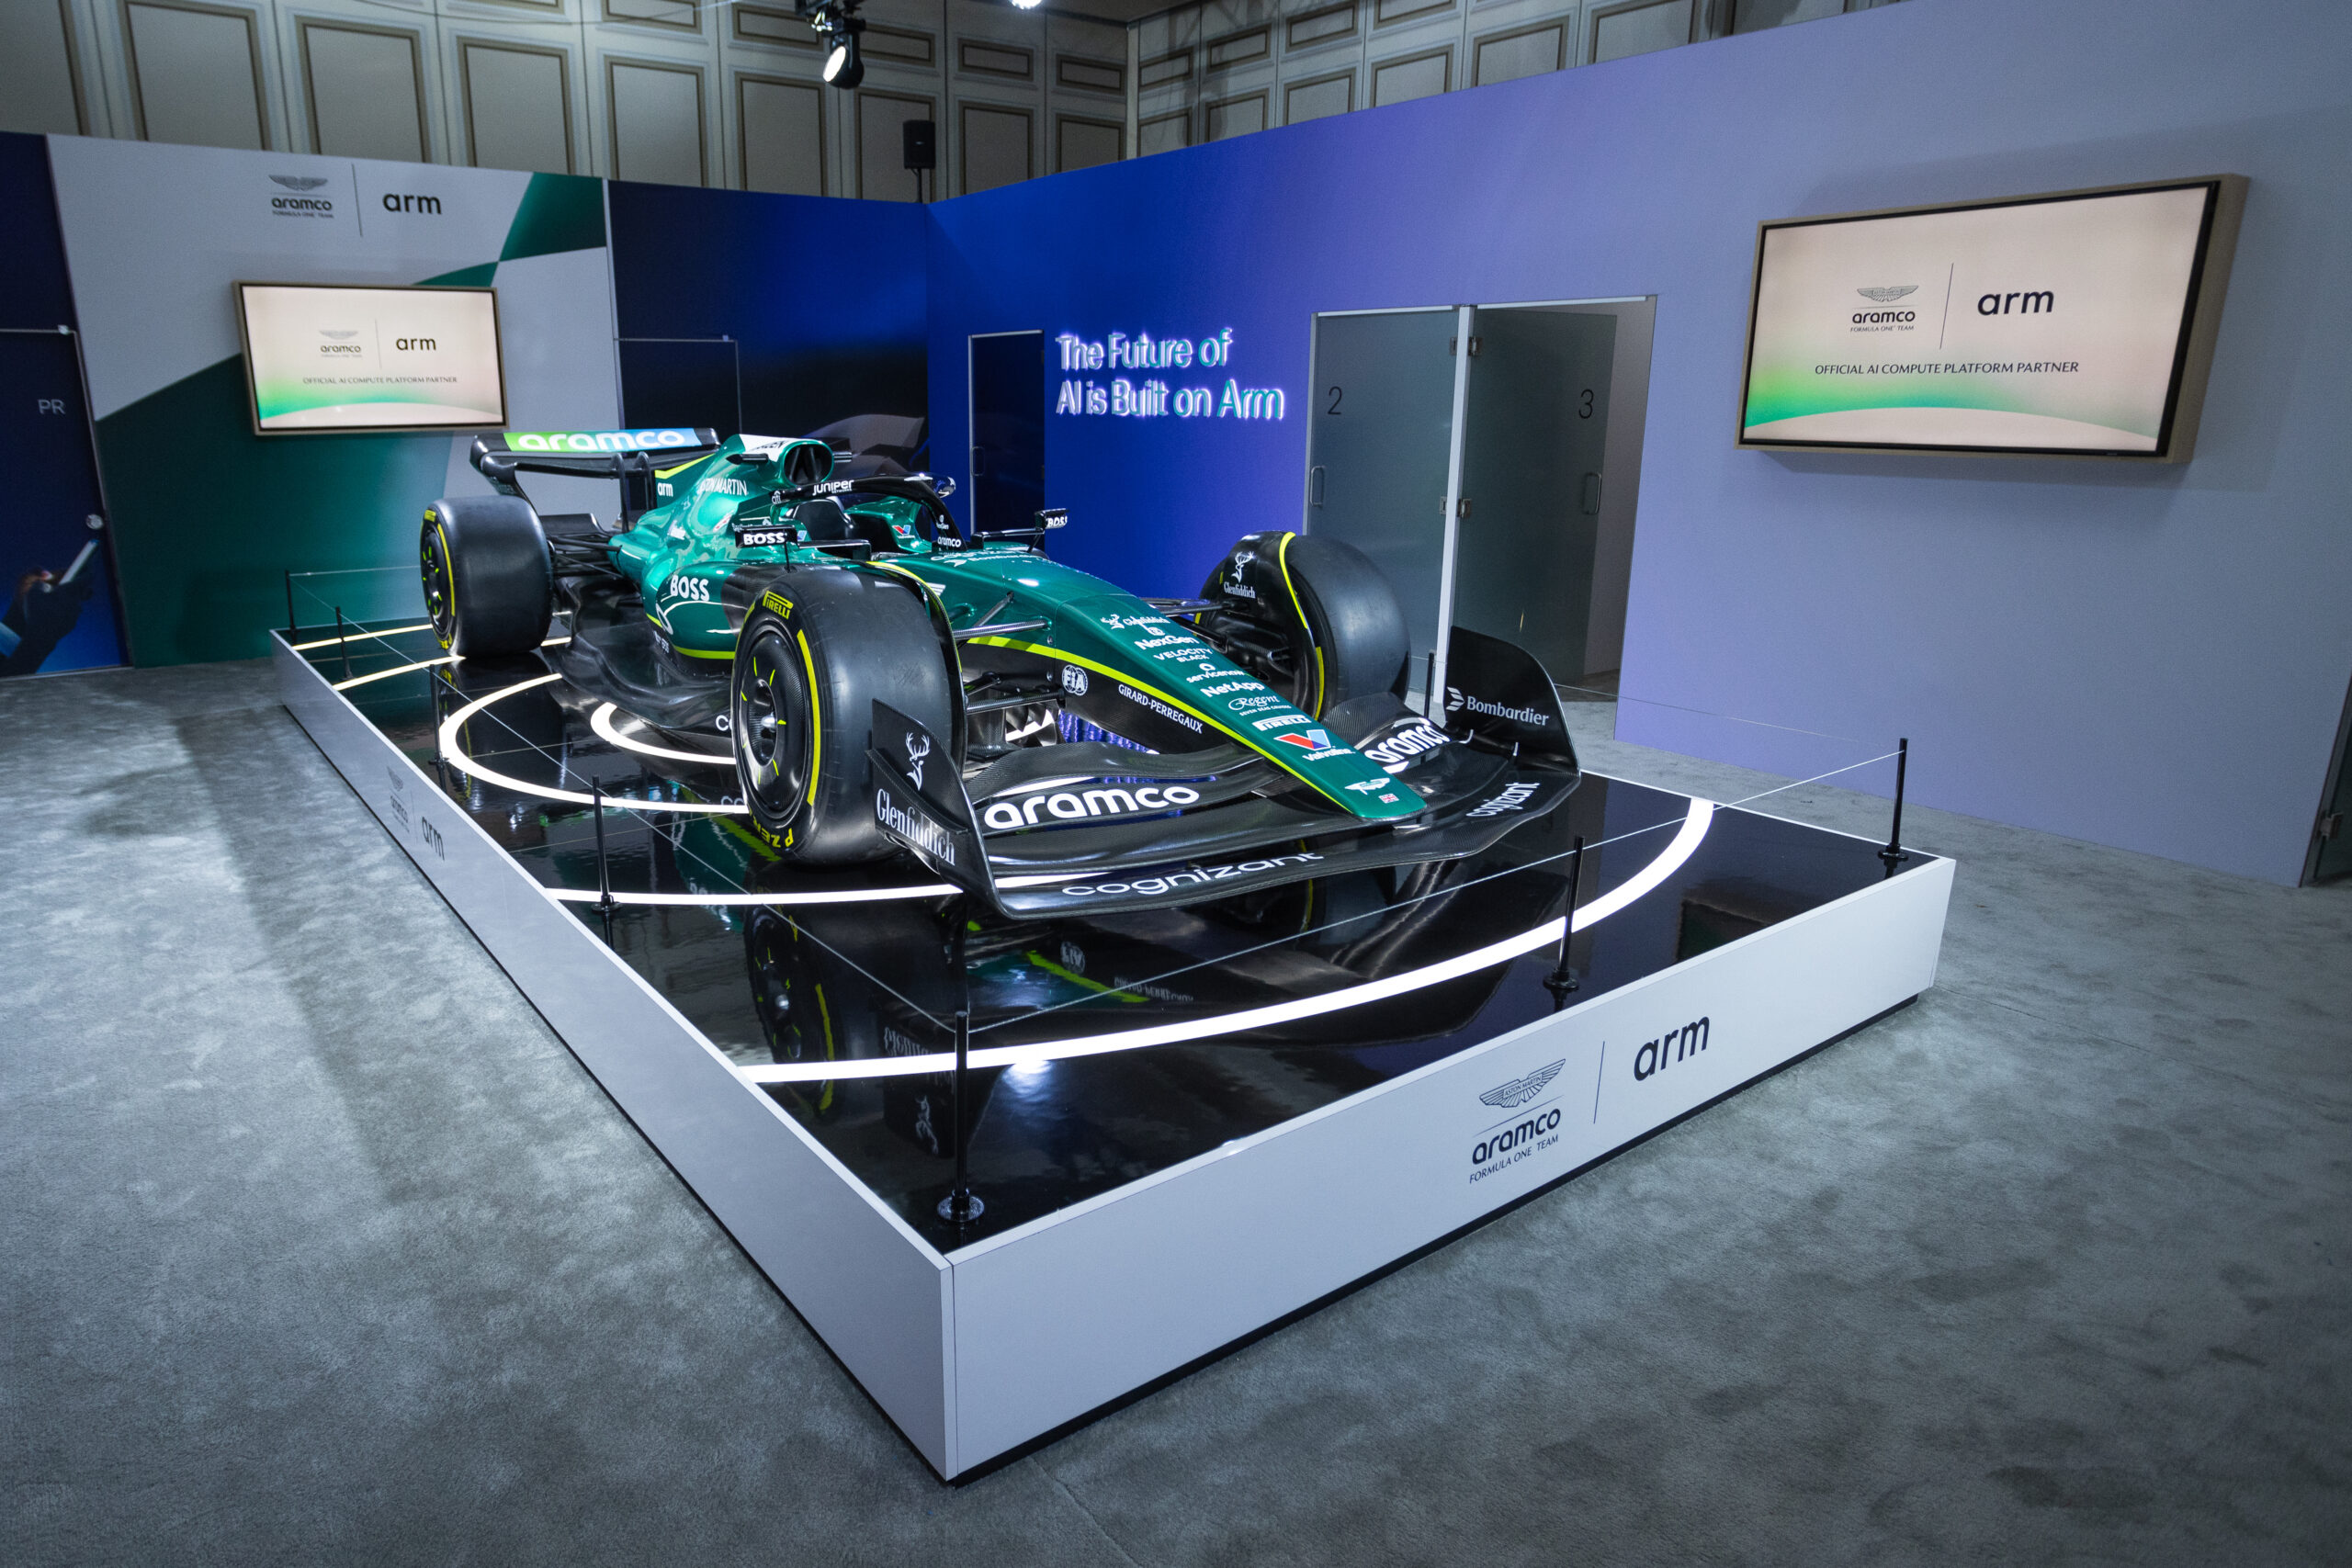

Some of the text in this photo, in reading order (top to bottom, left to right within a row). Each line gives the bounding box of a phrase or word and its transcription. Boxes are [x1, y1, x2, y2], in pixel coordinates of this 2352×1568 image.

[271, 197, 333, 212] aramco
[382, 193, 442, 215] arm
[1977, 290, 2054, 316] arm
[1852, 310, 1916, 324] aramco
[320, 344, 361, 353] aramco
[395, 337, 437, 351] arm
[1055, 326, 1233, 371] The Future of
[1815, 361, 2080, 375] OFFICIAL AI COMPUTE PLATFORM PARTNER
[38, 399, 66, 415] PR
[1056, 377, 1285, 421] AI is Built on Arm
[1328, 386, 1342, 415] 2
[1578, 389, 1594, 419] 3
[517, 429, 685, 452] aramco
[657, 482, 673, 497] arm
[742, 532, 786, 546] BOSS
[937, 536, 962, 548] aramco
[670, 573, 710, 603] BOSS
[1134, 635, 1201, 650] NexGen
[1153, 648, 1214, 661] VELOCITY
[1176, 654, 1210, 663] BLACK
[1063, 669, 1086, 693] FIA
[1200, 681, 1266, 698] NetApp
[1118, 683, 1204, 734] GIRARD-PERREGAUX
[1466, 695, 1550, 727] Bombardier
[1364, 724, 1451, 764] aramco
[984, 785, 1200, 830] aramco
[1465, 782, 1541, 818] cognizant
[421, 816, 446, 862] arm
[876, 787, 956, 867] Glenfiddich
[1060, 851, 1325, 897] cognizant
[1633, 1015, 1711, 1082] arm
[1504, 1076, 1542, 1096] ASTON MARTIN
[1472, 1108, 1561, 1166] aramco
[1469, 1134, 1559, 1184] FORMULA ONE TEAM
